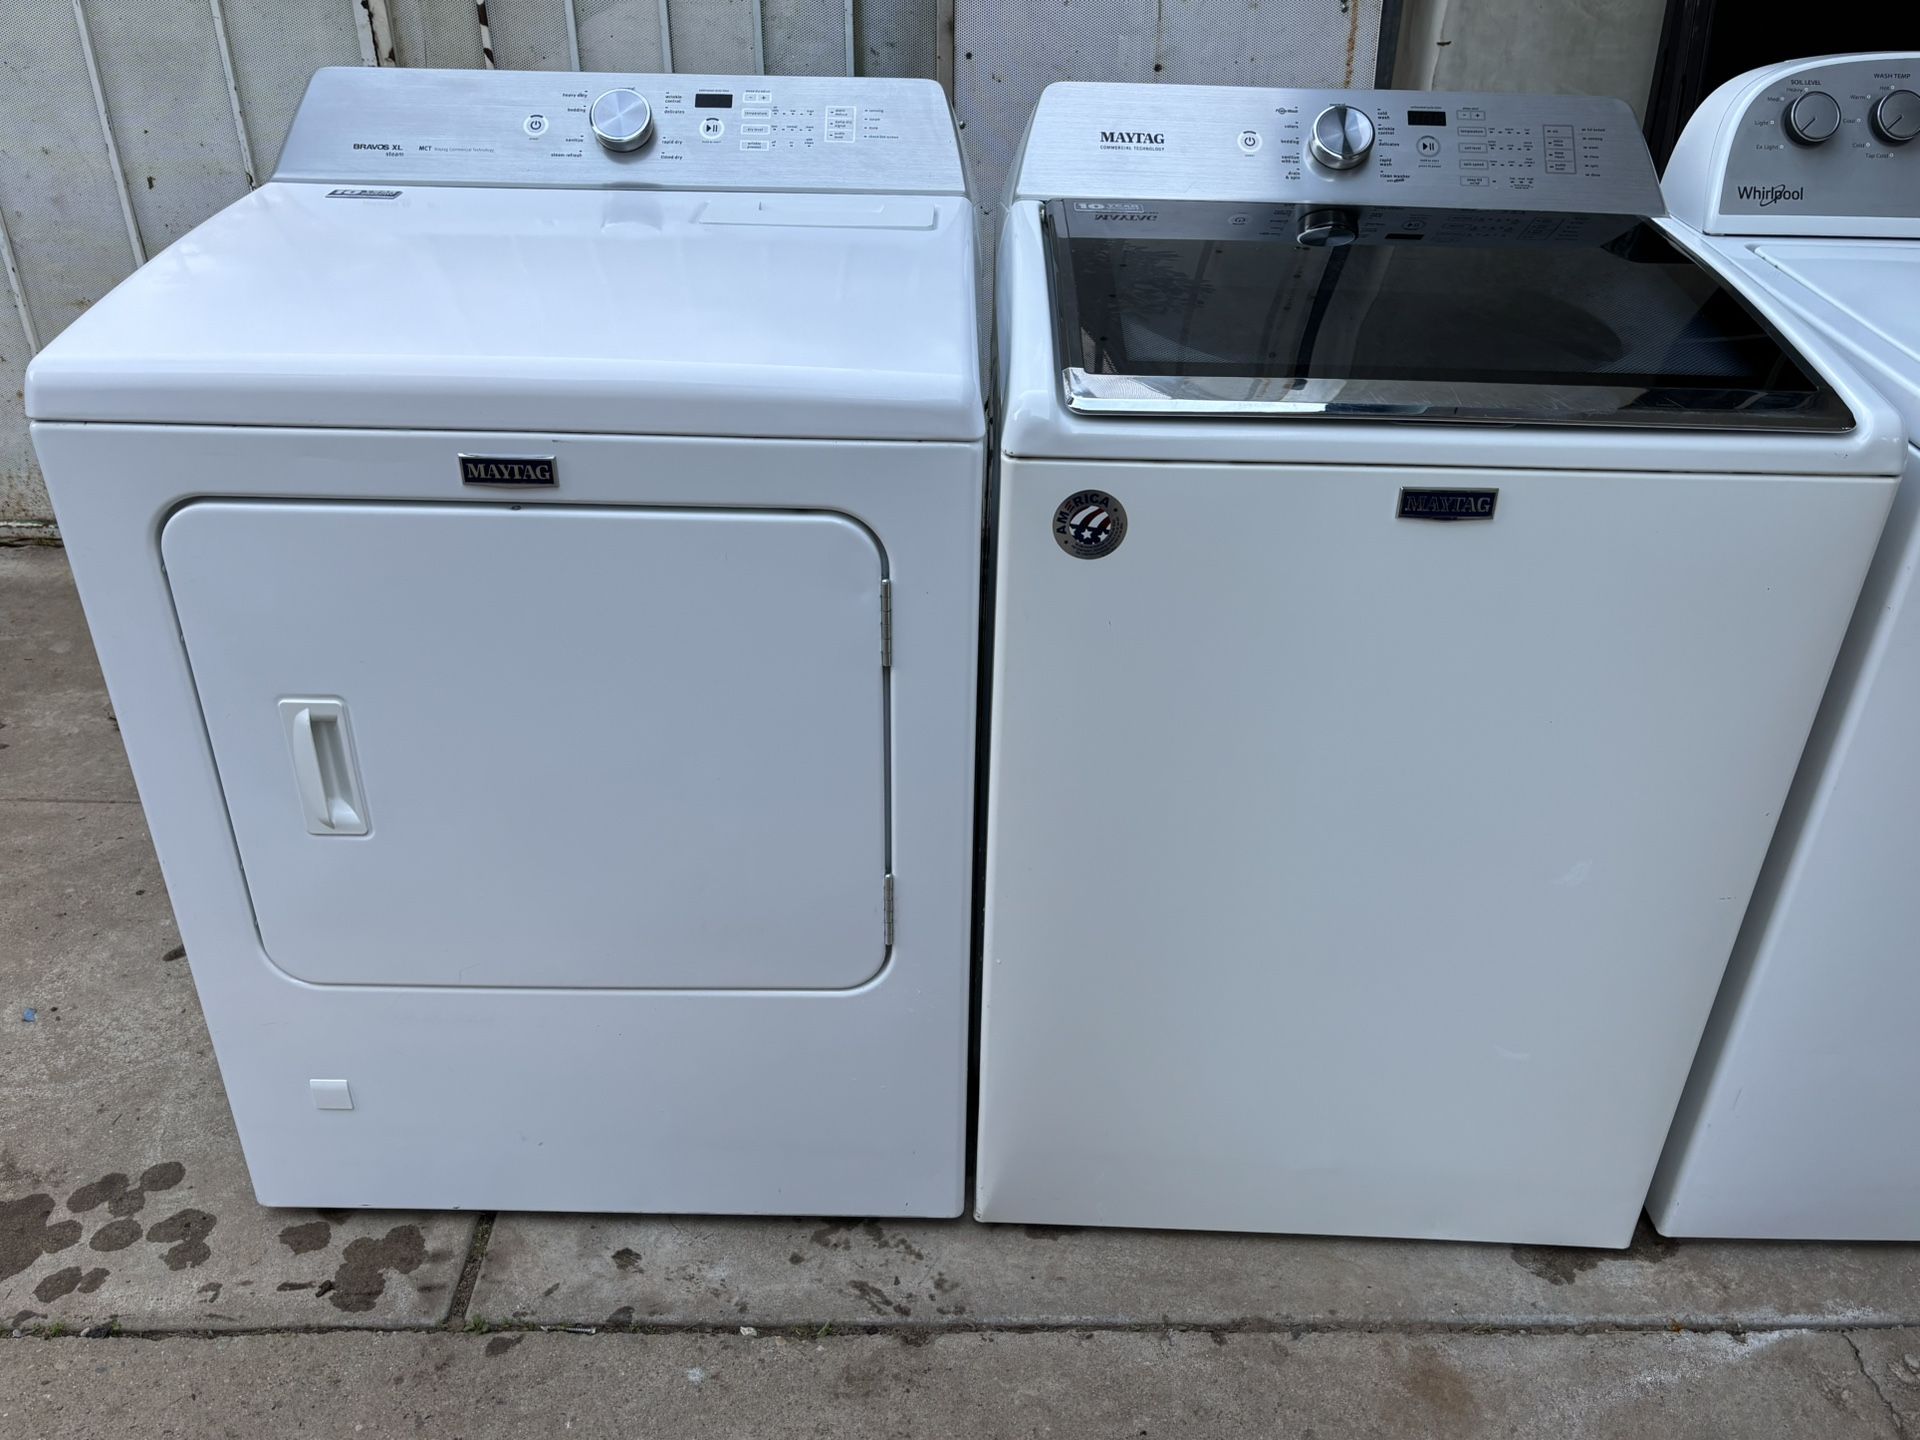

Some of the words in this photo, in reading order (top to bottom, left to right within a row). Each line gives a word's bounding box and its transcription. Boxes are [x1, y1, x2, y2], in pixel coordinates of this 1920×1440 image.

[1100, 131, 1165, 144] MAYTAG
[1738, 184, 1803, 206] Whirlpool
[466, 463, 550, 480] MAYTAG
[1405, 496, 1490, 513] MAYTAG
[1056, 493, 1110, 535] AMERICA
